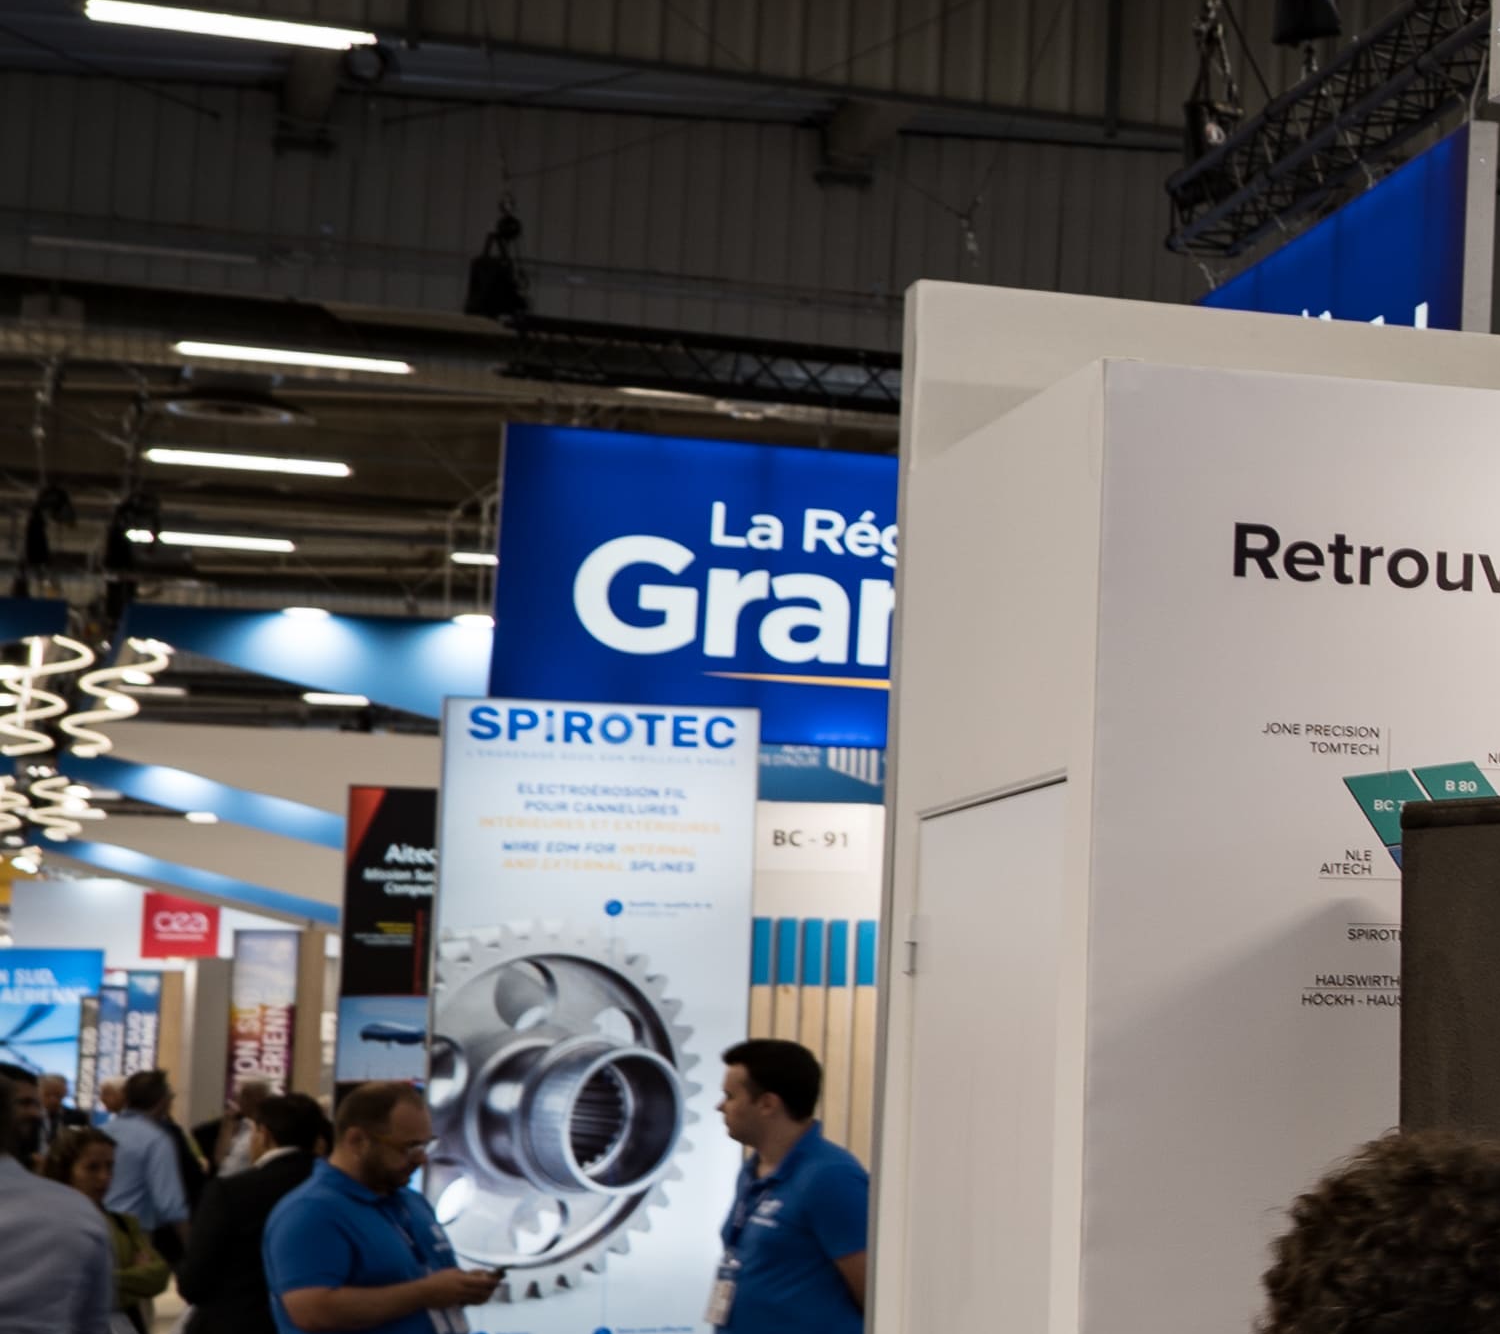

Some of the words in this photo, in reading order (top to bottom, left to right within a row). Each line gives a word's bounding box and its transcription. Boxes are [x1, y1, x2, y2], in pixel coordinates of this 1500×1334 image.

[711, 503, 783, 551] La
[1262, 722, 1300, 735] JONE
[1305, 724, 1380, 739] PRECISION
[1310, 741, 1379, 755] TOMTECH
[1446, 780, 1456, 792] B
[1459, 781, 1478, 792] 80
[525, 800, 568, 812] POUR
[1373, 800, 1394, 811] BC
[773, 829, 802, 847] BC
[824, 831, 848, 847] 91
[1345, 850, 1372, 861] NLE
[1320, 863, 1372, 875] AITECH
[153, 911, 210, 933] cea
[1315, 974, 1400, 987] HAUSWIRTH
[1302, 993, 1352, 1007] HÖCKH
